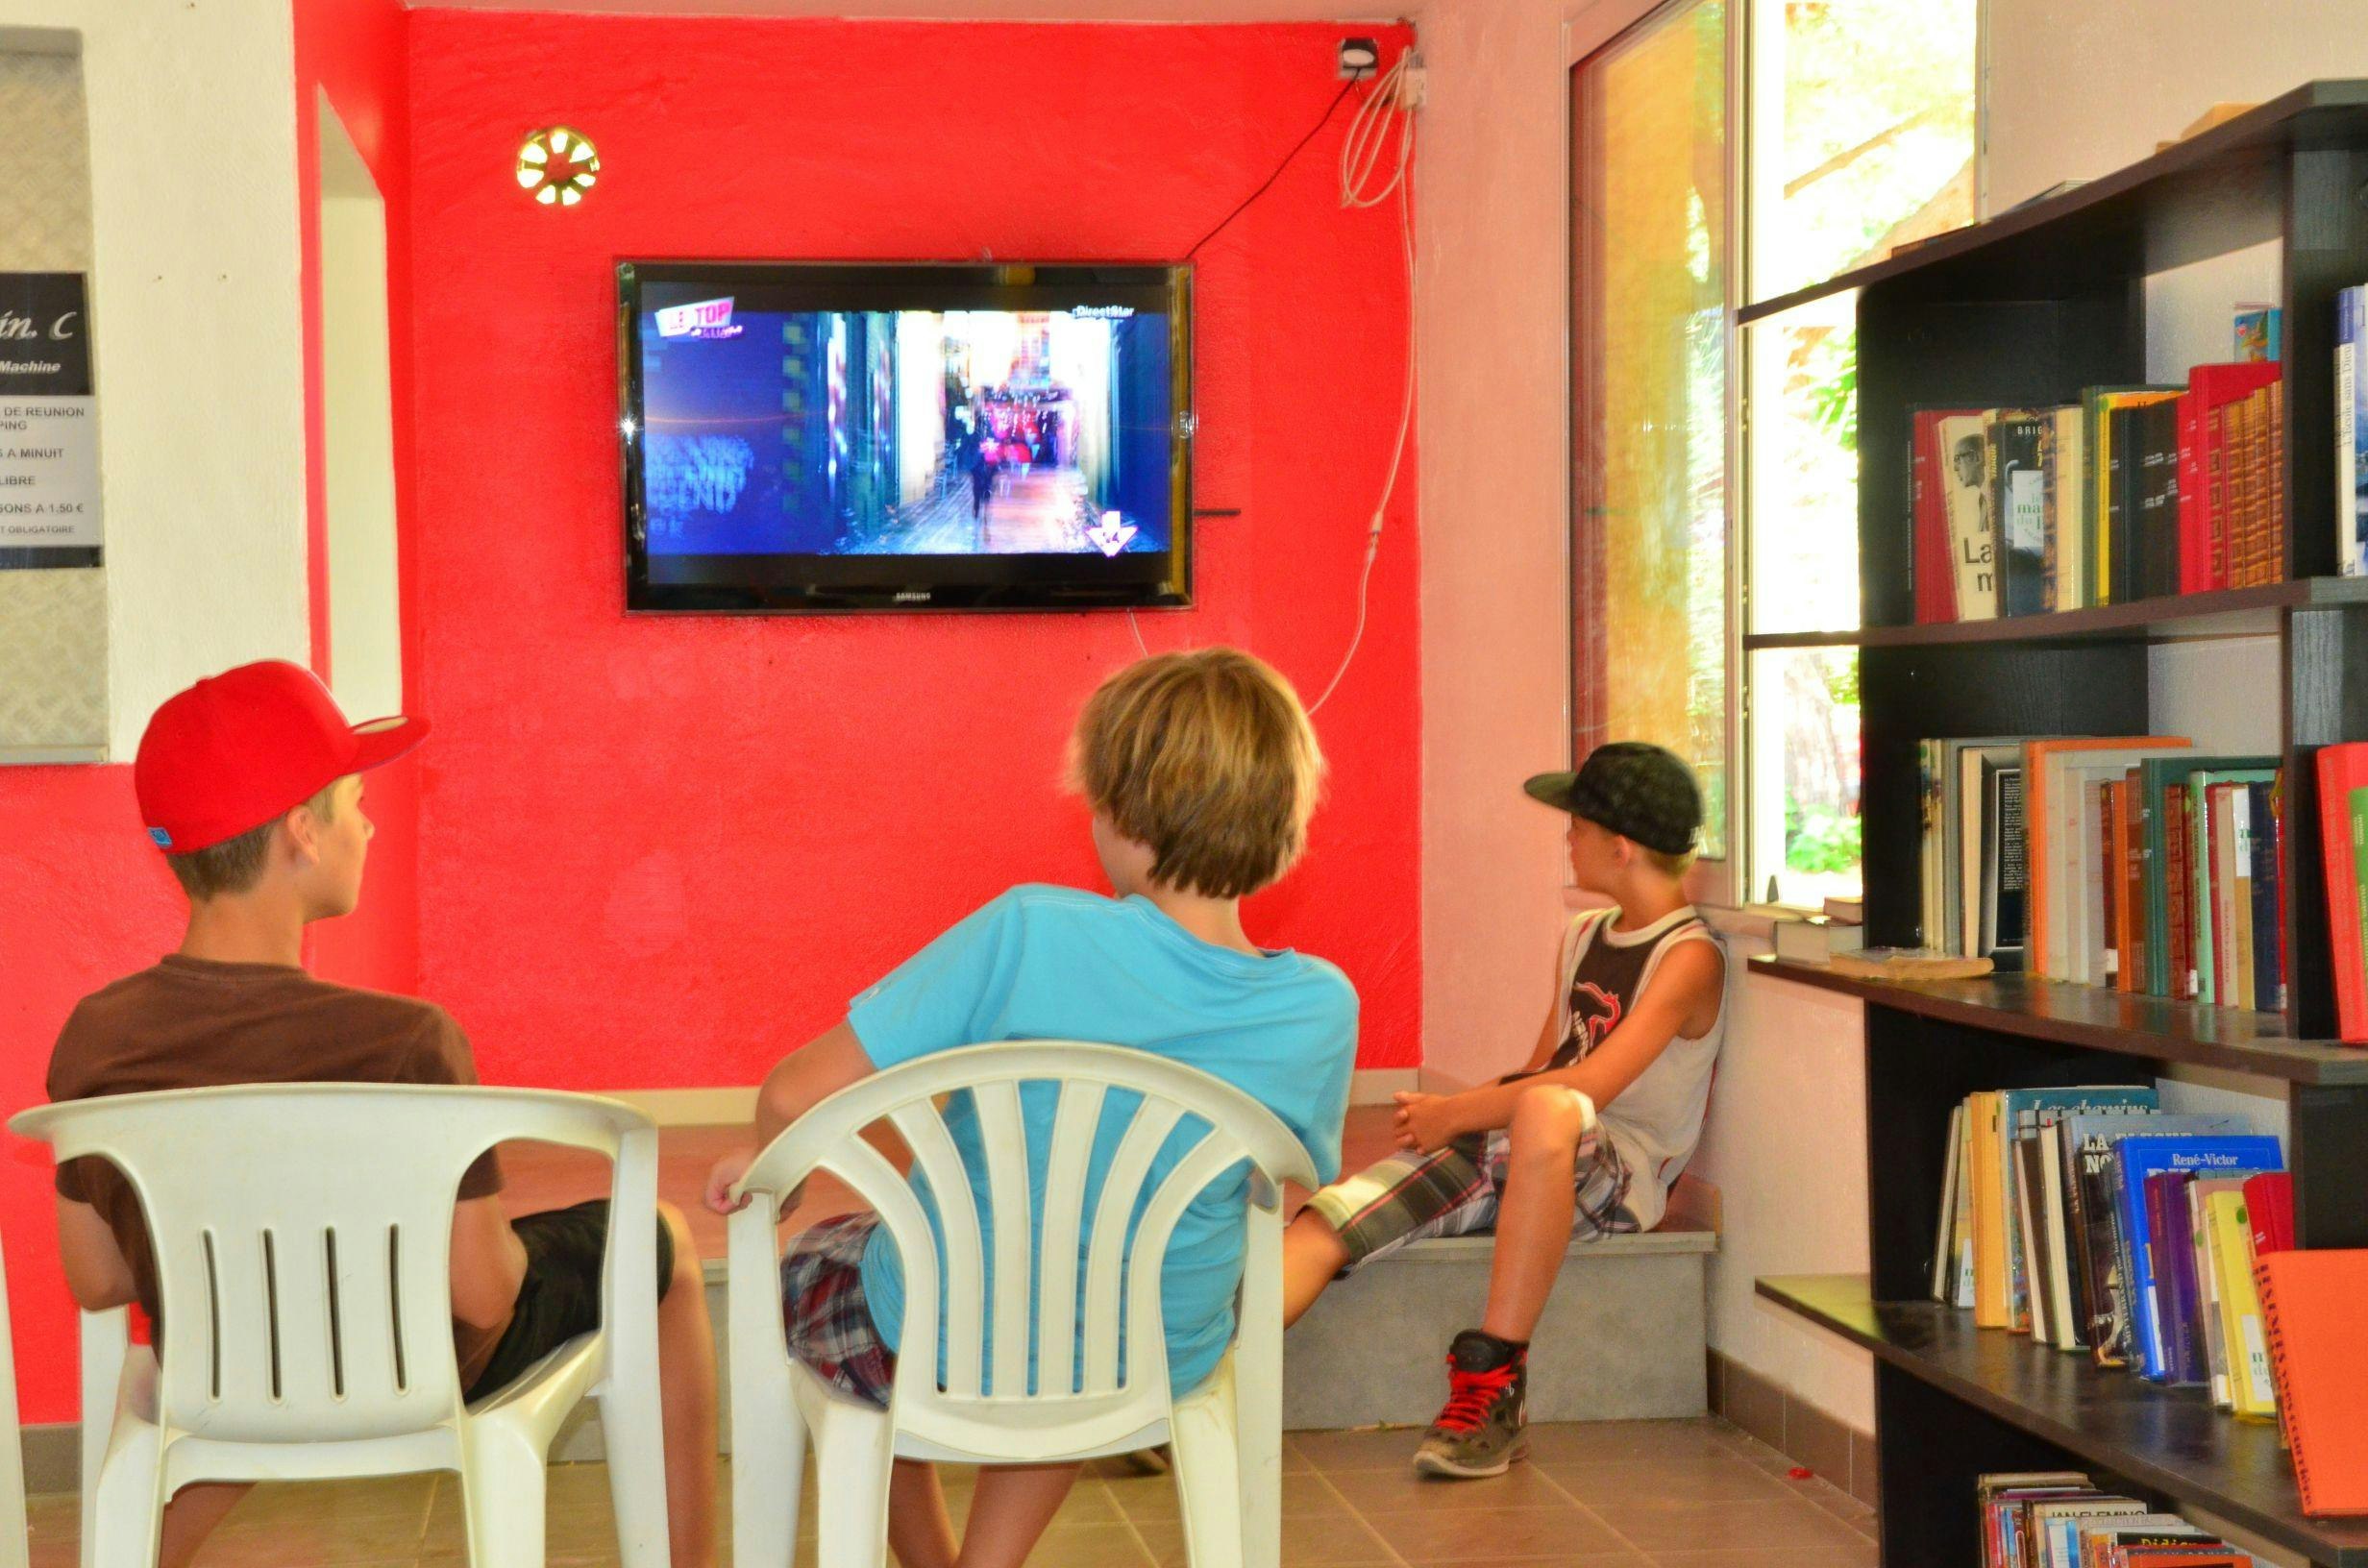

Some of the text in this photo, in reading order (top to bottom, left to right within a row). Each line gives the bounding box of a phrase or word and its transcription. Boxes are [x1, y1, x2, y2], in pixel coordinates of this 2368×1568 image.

[695, 301, 731, 327] TOP
[0, 360, 62, 375] Machine
[2343, 376, 2353, 401] sans
[4, 406, 85, 417] DE REUNION
[8, 449, 16, 458] A
[20, 449, 64, 458] MINUIT
[36, 503, 44, 514] A
[76, 503, 84, 513] €
[8, 526, 75, 534] OBLIGATOIRE
[1963, 537, 1991, 564] La
[2083, 1133, 2109, 1151] LA
[2172, 1153, 2238, 1166] René-Victor
